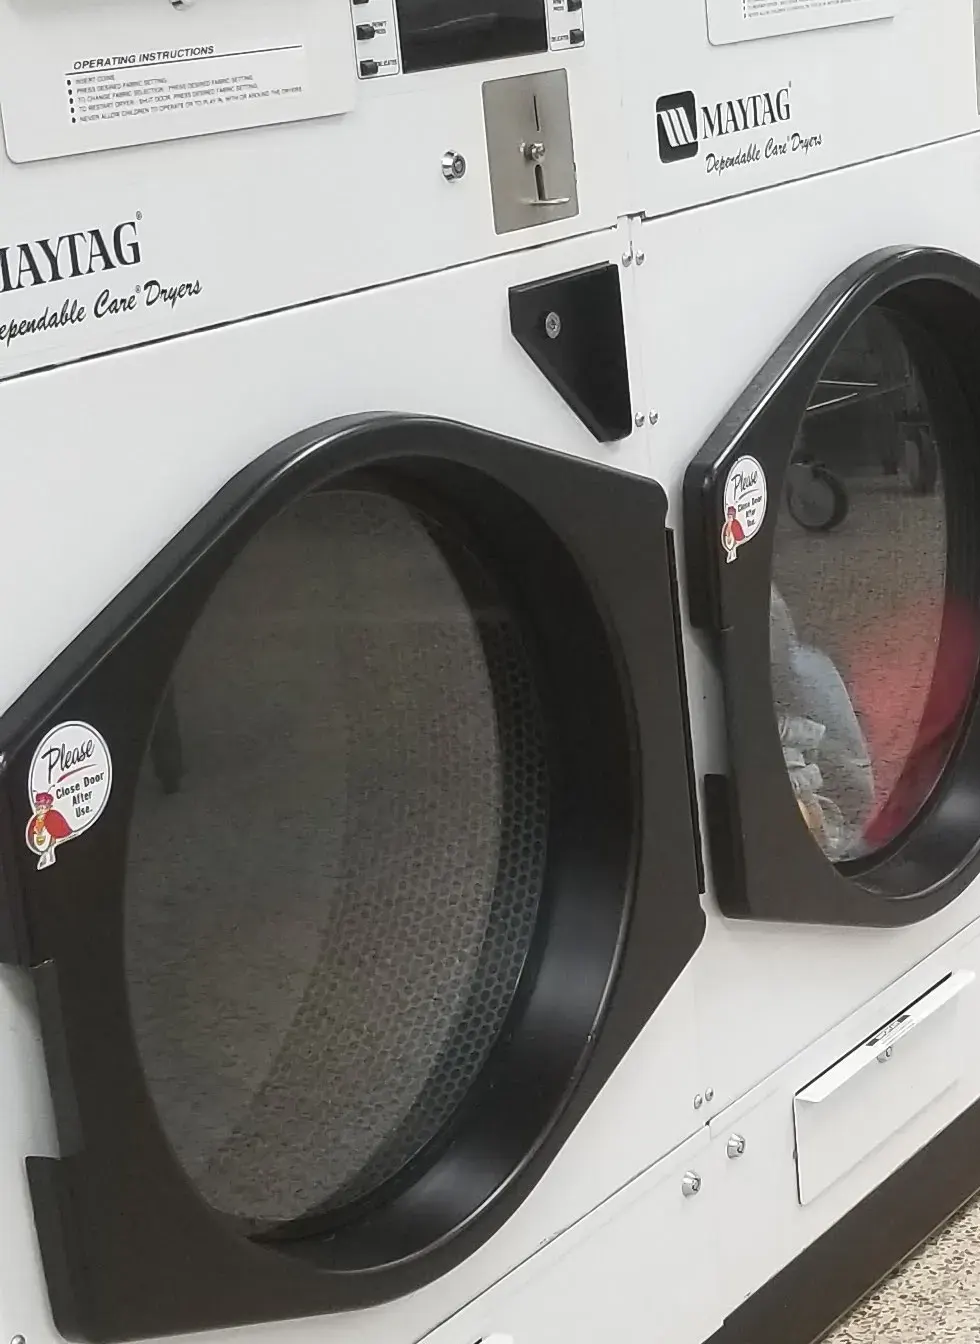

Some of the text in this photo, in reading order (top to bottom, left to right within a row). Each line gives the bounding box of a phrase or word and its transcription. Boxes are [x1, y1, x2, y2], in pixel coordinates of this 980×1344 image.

[73, 45, 214, 70] OPERATING INSTRUCTIONS
[701, 87, 791, 140] MAYTAG
[706, 132, 822, 176] Dependable Care Dryers
[0, 279, 202, 348] ependable Care Dryers
[730, 470, 758, 501] Please
[41, 739, 95, 785] Please
[56, 771, 105, 800] Close Door
[72, 790, 93, 807] After
[75, 806, 94, 818] Use.
